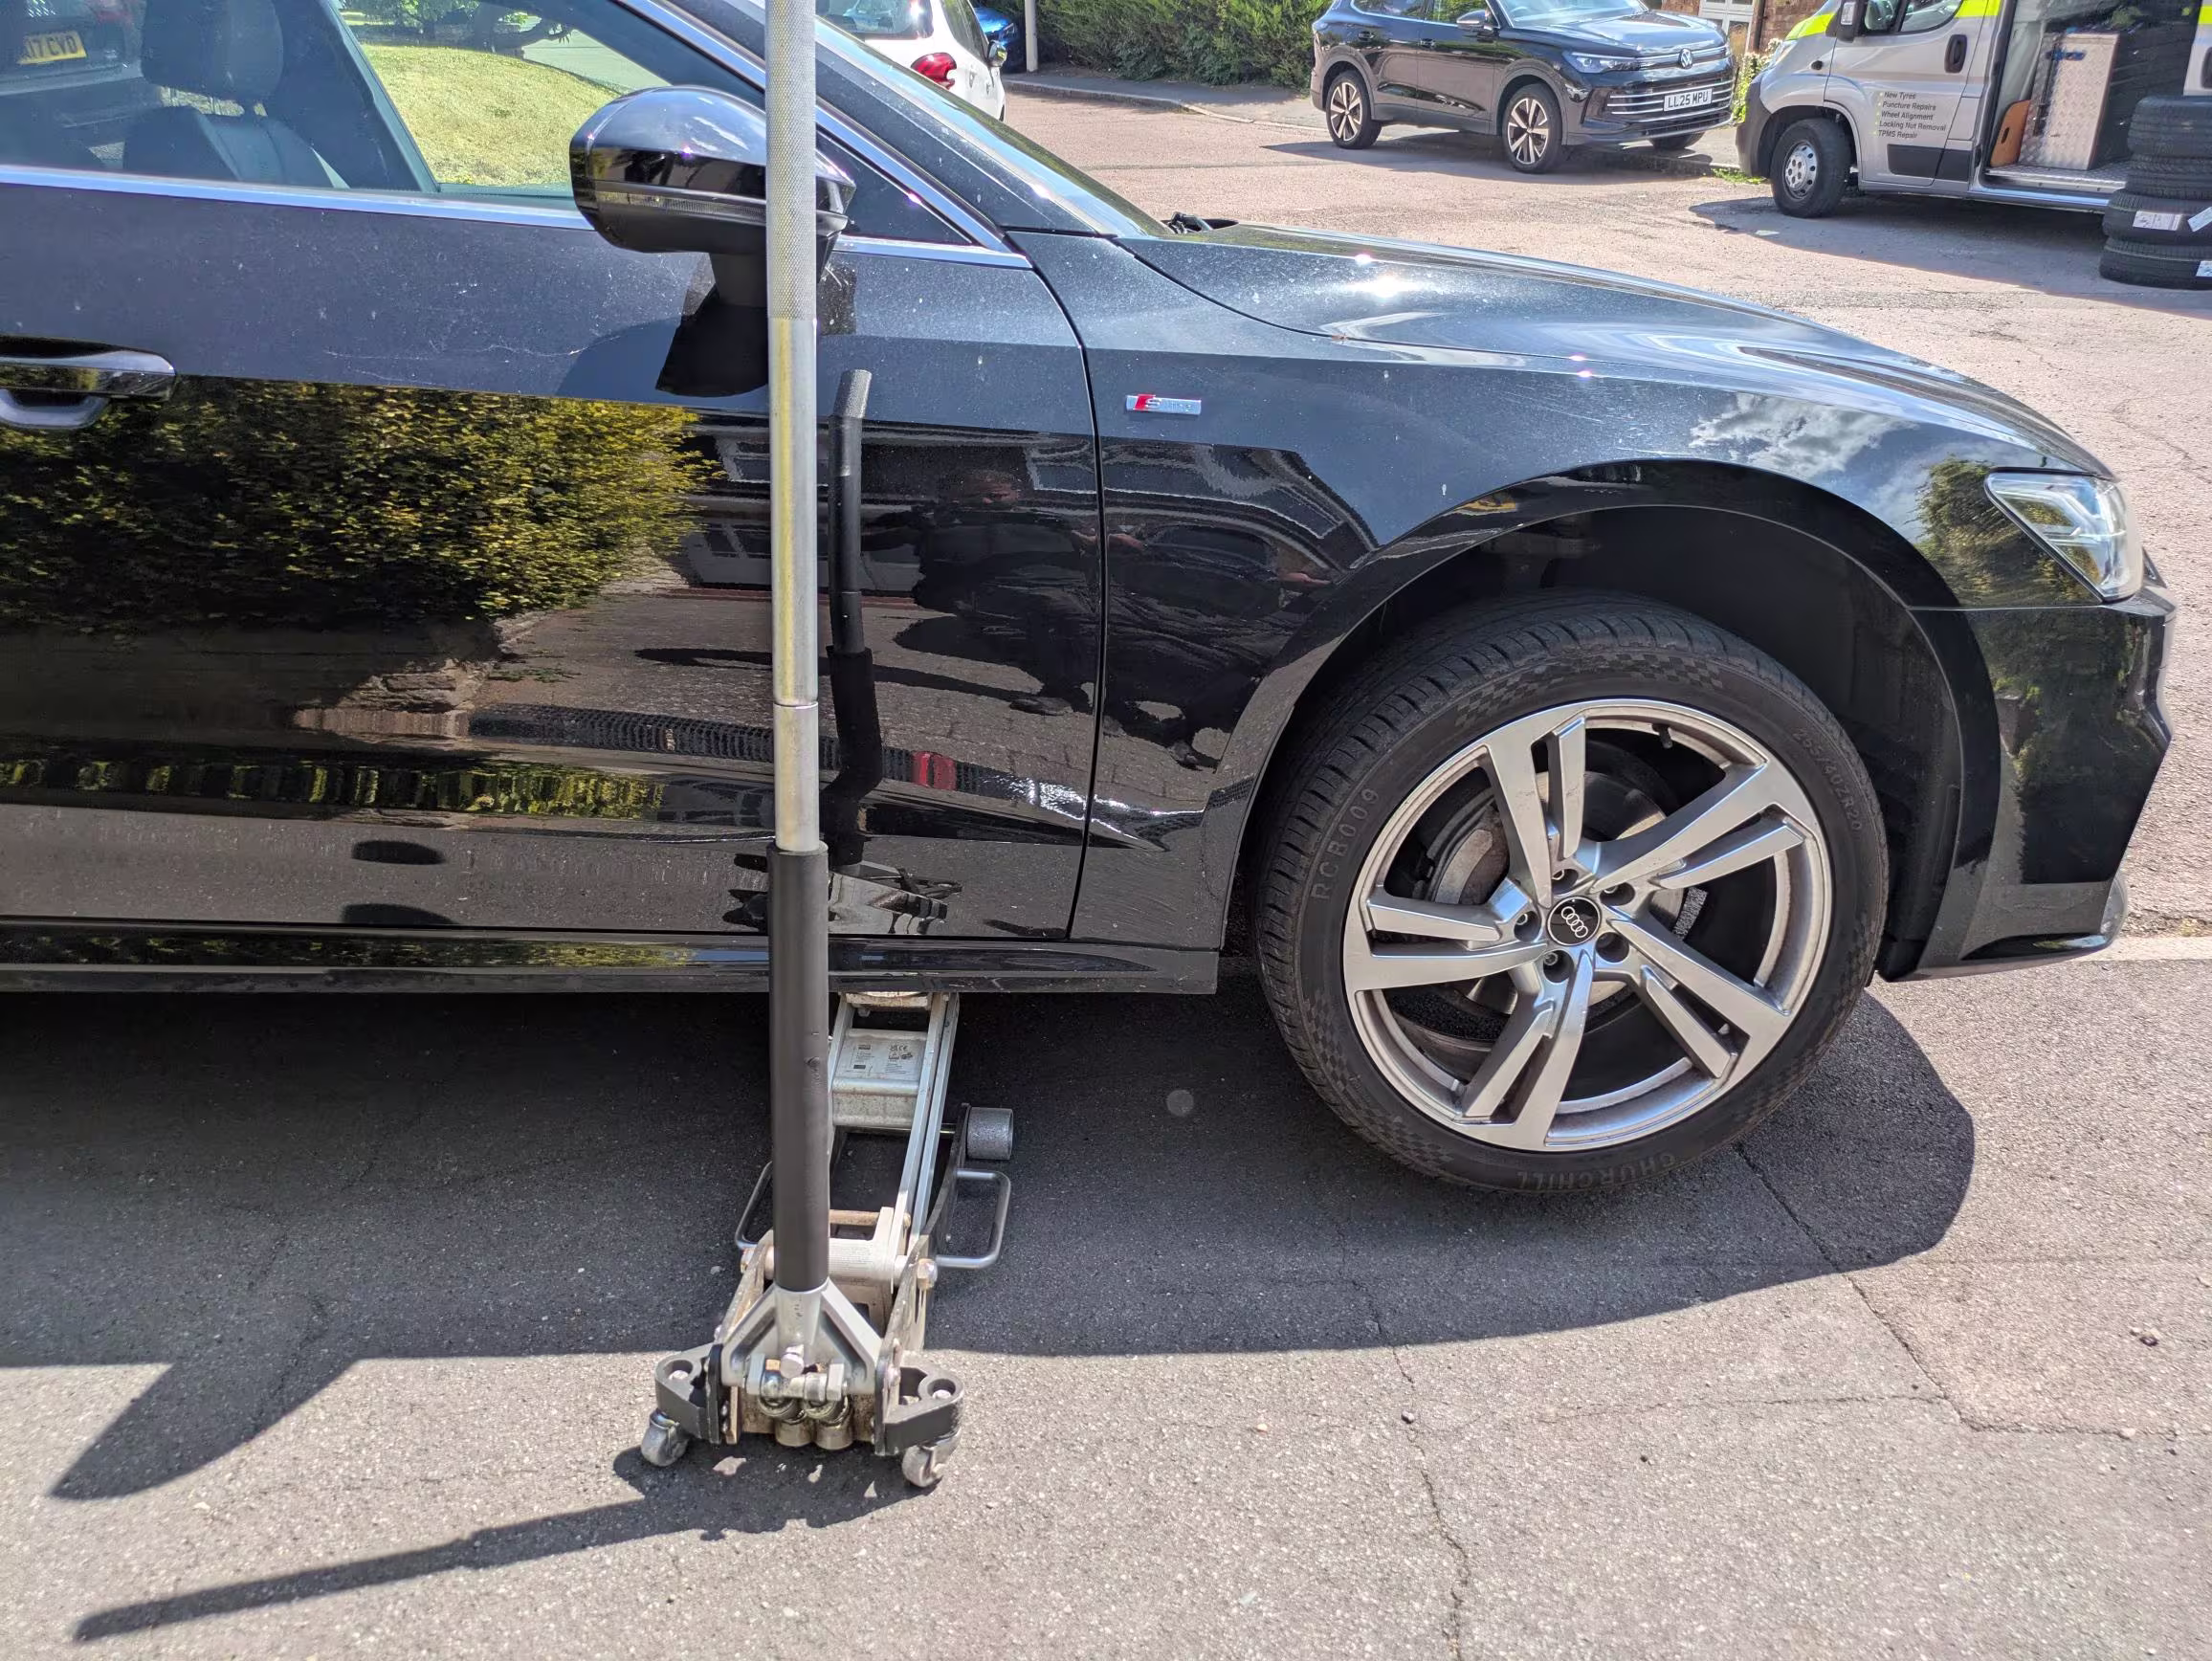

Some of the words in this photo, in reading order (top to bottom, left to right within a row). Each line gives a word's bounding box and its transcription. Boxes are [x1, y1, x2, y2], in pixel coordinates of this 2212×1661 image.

[1668, 93, 1691, 108] LL25
[1692, 90, 1709, 104] MPU
[1882, 100, 1911, 109] Puncture
[1912, 102, 1936, 111] Repairs
[1901, 112, 1934, 121] Alignment
[1879, 121, 1904, 129] Locking
[1917, 122, 1947, 131] Removal
[1878, 129, 1896, 138] TPMS
[1310, 787, 1379, 900] RCB009
[1516, 1151, 1675, 1190] CHURCHILL
